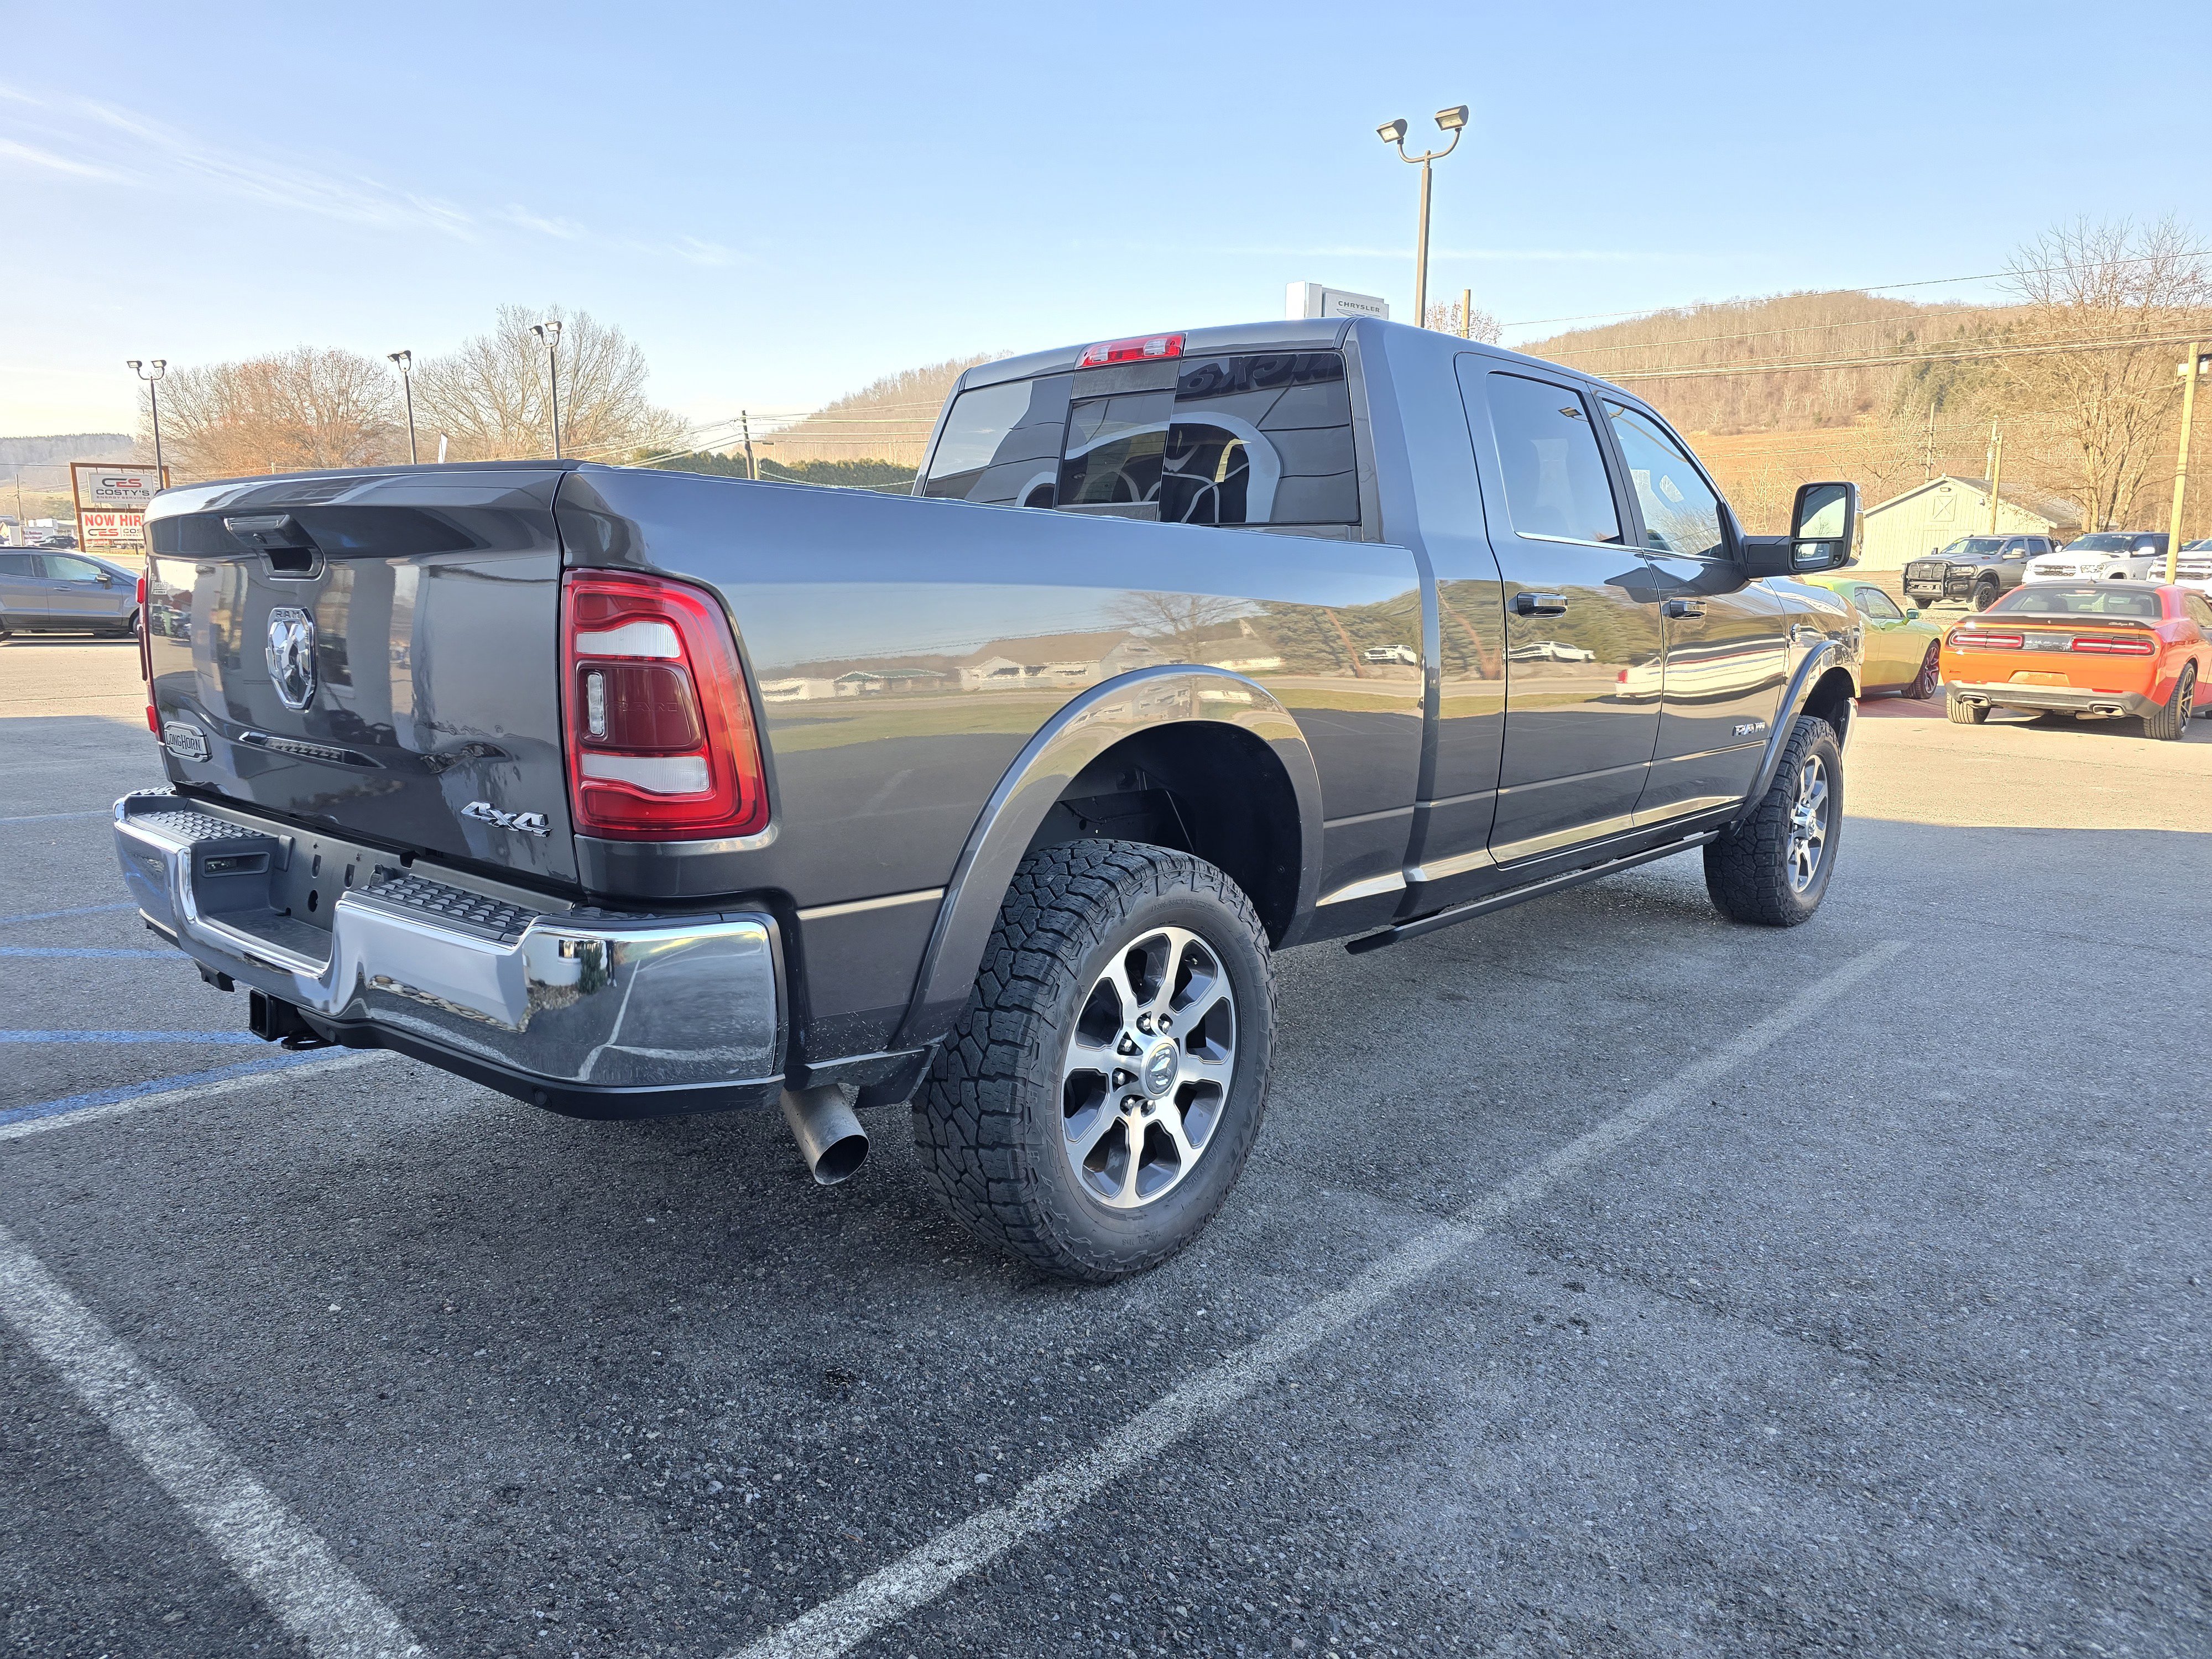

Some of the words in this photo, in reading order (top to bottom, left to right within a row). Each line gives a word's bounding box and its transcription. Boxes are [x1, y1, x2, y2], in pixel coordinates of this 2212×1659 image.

[1338, 300, 1380, 313] CHRYSLER
[102, 478, 142, 488] CES
[85, 514, 115, 526] NOW
[88, 528, 118, 536] CES
[275, 610, 301, 619] RAM
[611, 701, 677, 712] RAM
[1733, 719, 1766, 737] RAM
[1237, 930, 1267, 1103] WILDPEAK
[1044, 983, 1084, 1171] FALKEN
